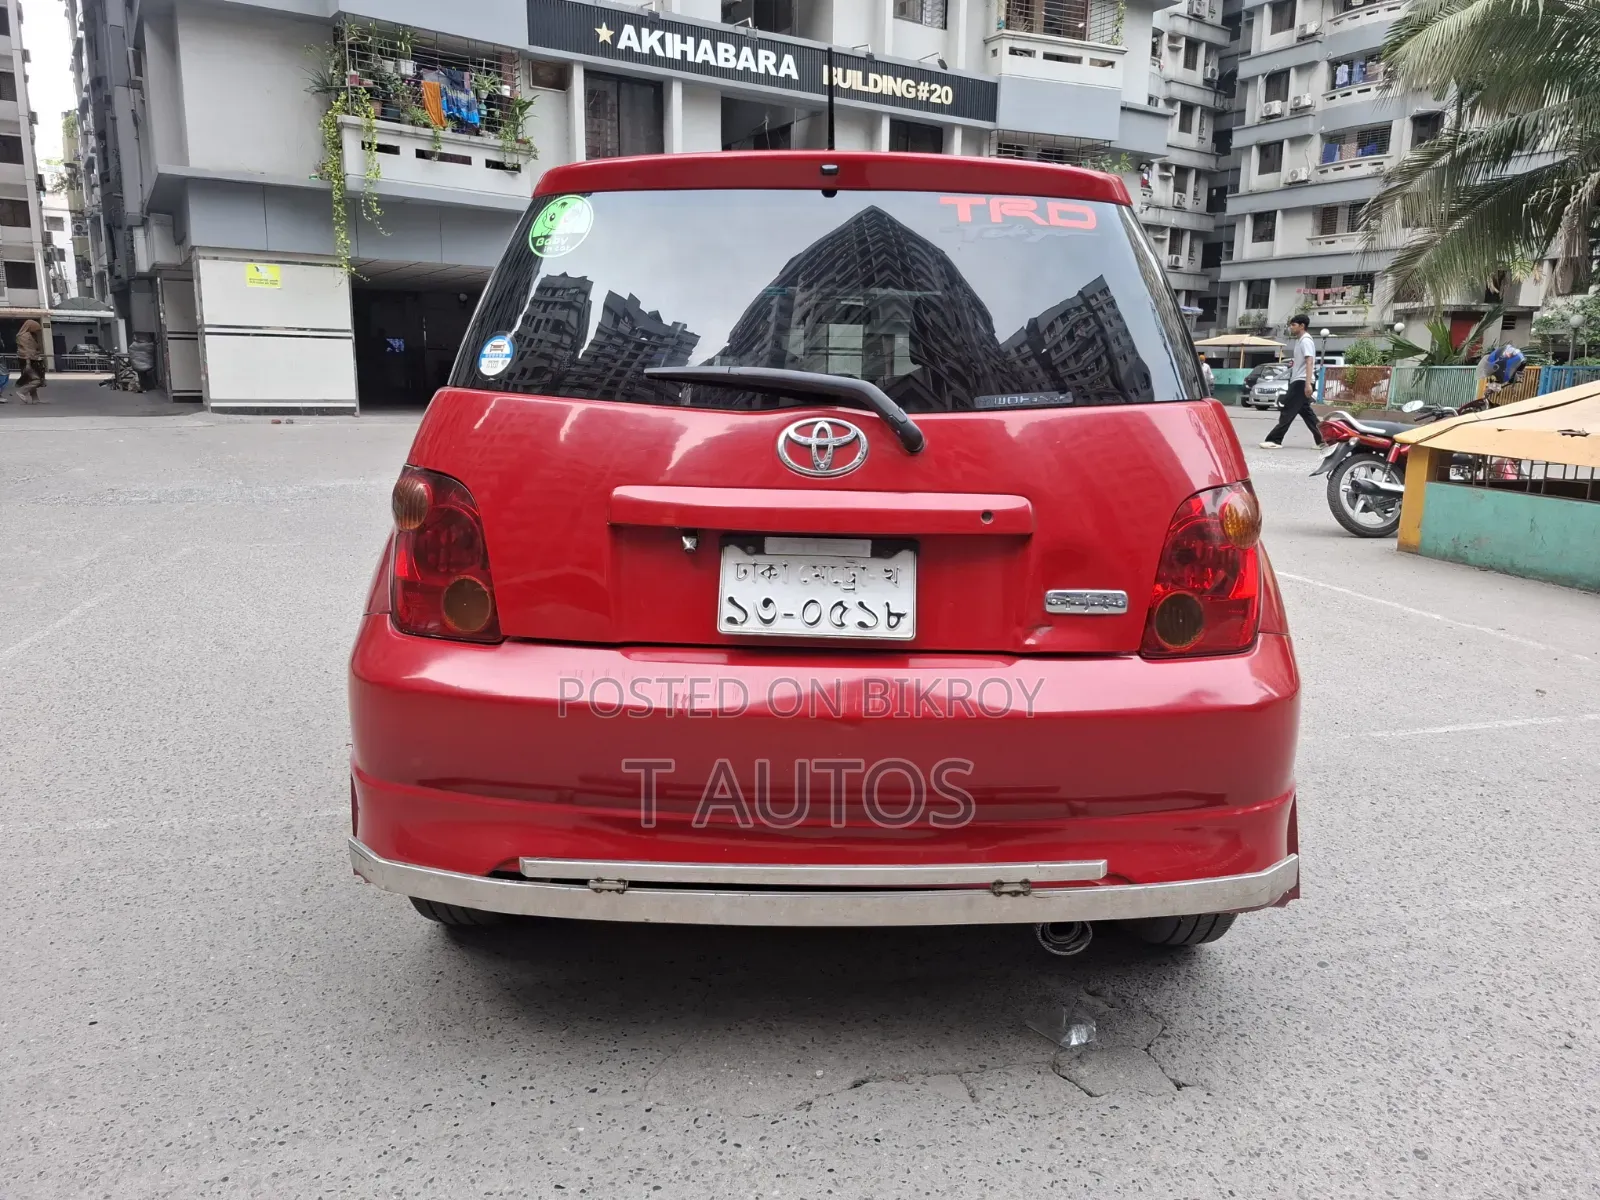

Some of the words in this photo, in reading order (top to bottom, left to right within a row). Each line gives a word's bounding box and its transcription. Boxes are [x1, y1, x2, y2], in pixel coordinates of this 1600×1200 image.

[617, 24, 799, 80] AKIHABARA
[939, 196, 1097, 230] TRD
[724, 595, 908, 630] ১৩-০৫১৮
